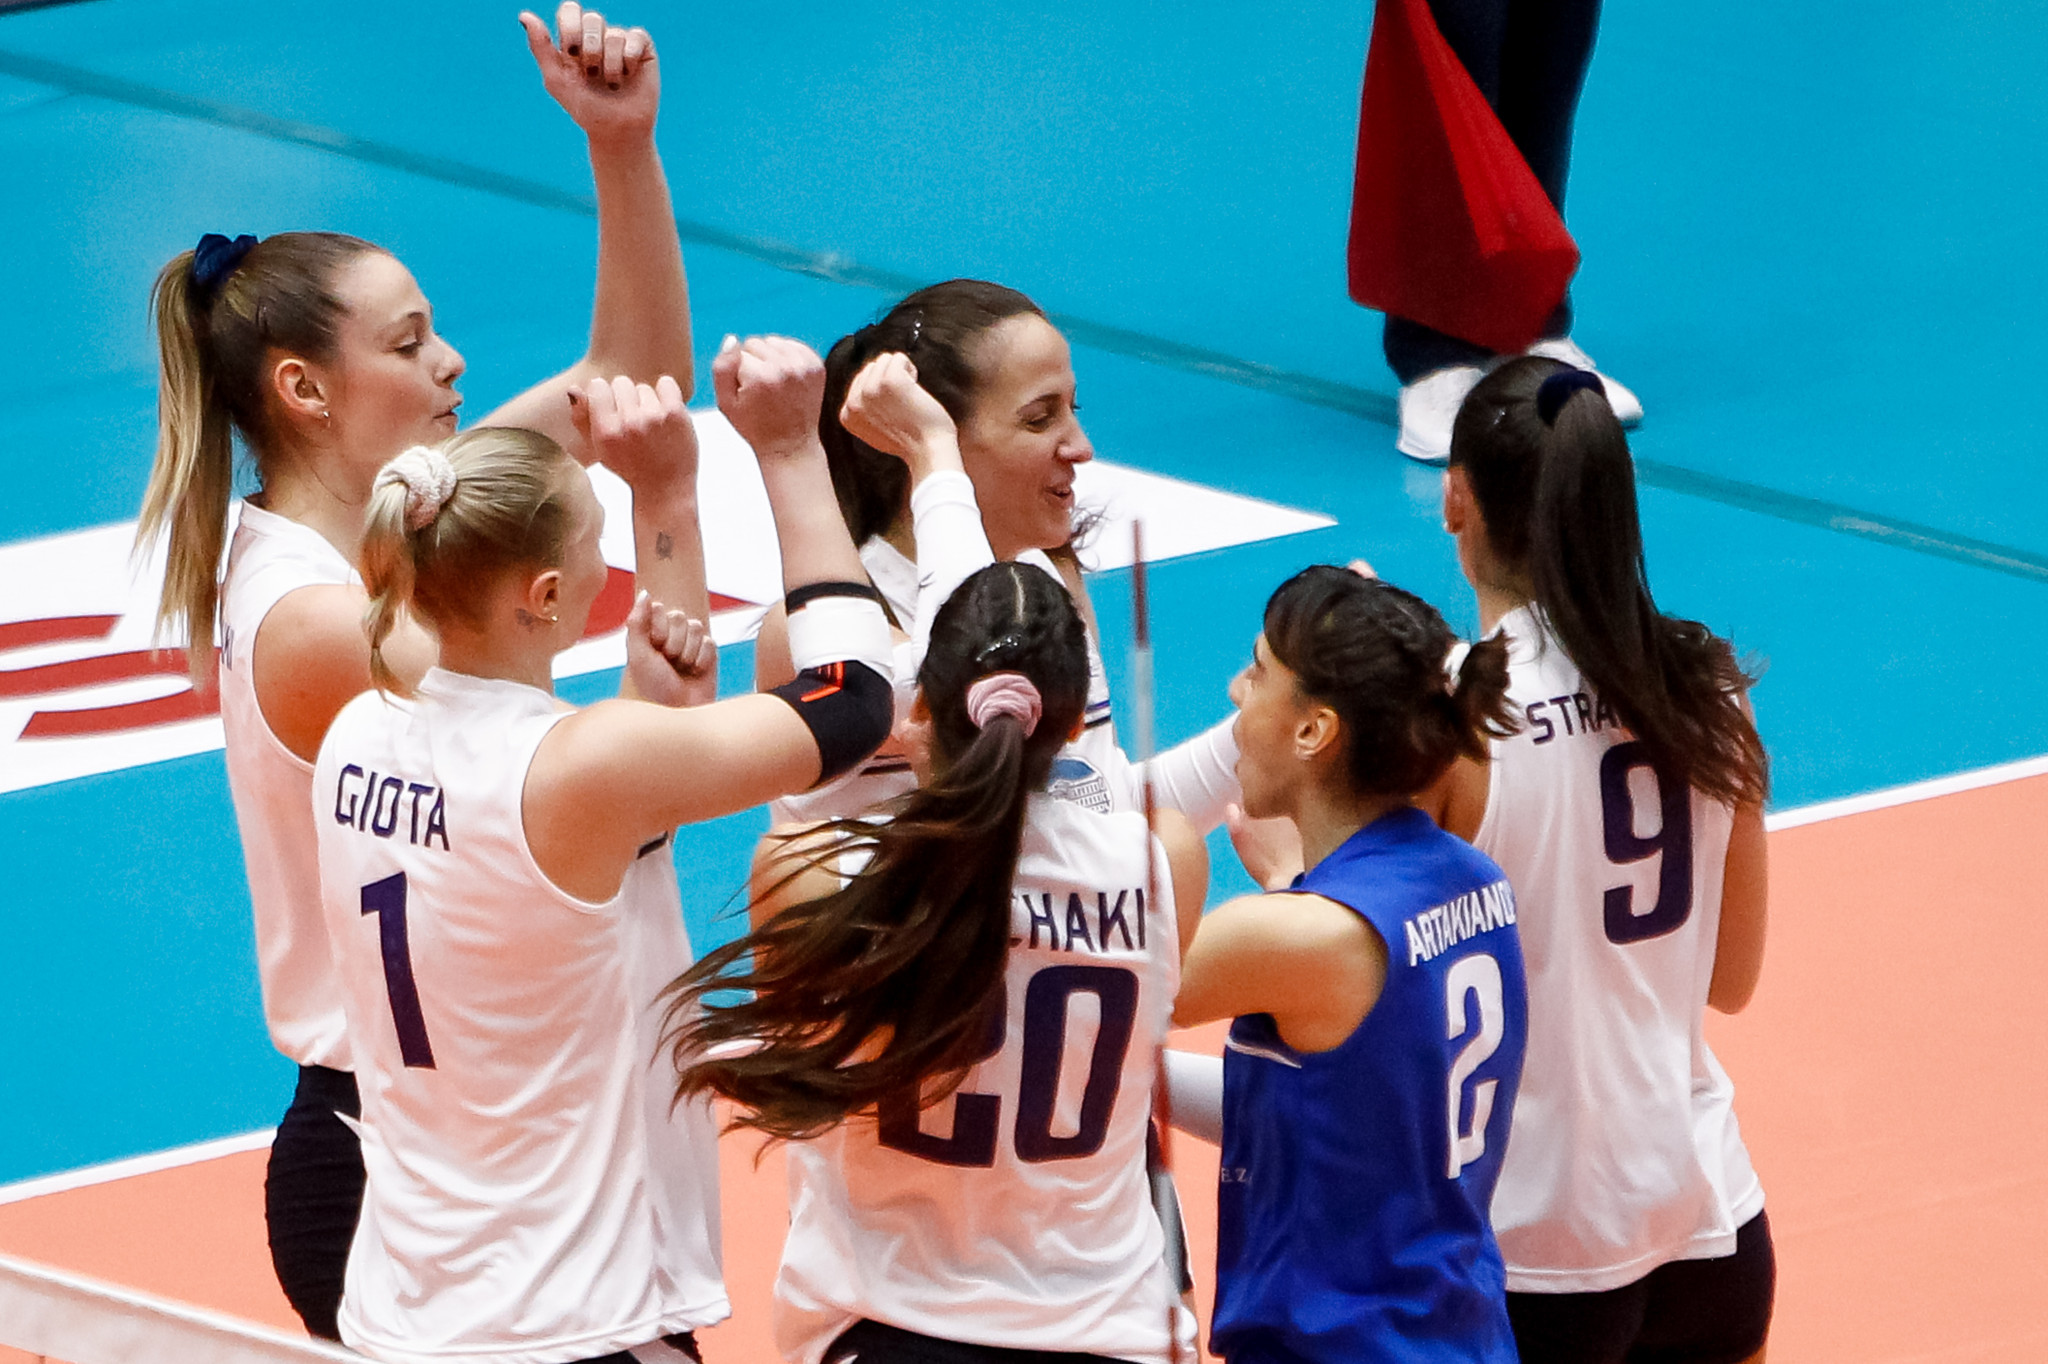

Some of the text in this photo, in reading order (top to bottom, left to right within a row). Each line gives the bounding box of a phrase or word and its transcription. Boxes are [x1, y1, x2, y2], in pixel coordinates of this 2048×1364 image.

[335, 763, 450, 851] GIOTA
[1601, 738, 1692, 944] 9
[361, 871, 437, 1070] 1
[1010, 888, 1146, 951] HAKI
[1446, 953, 1504, 1181] 2
